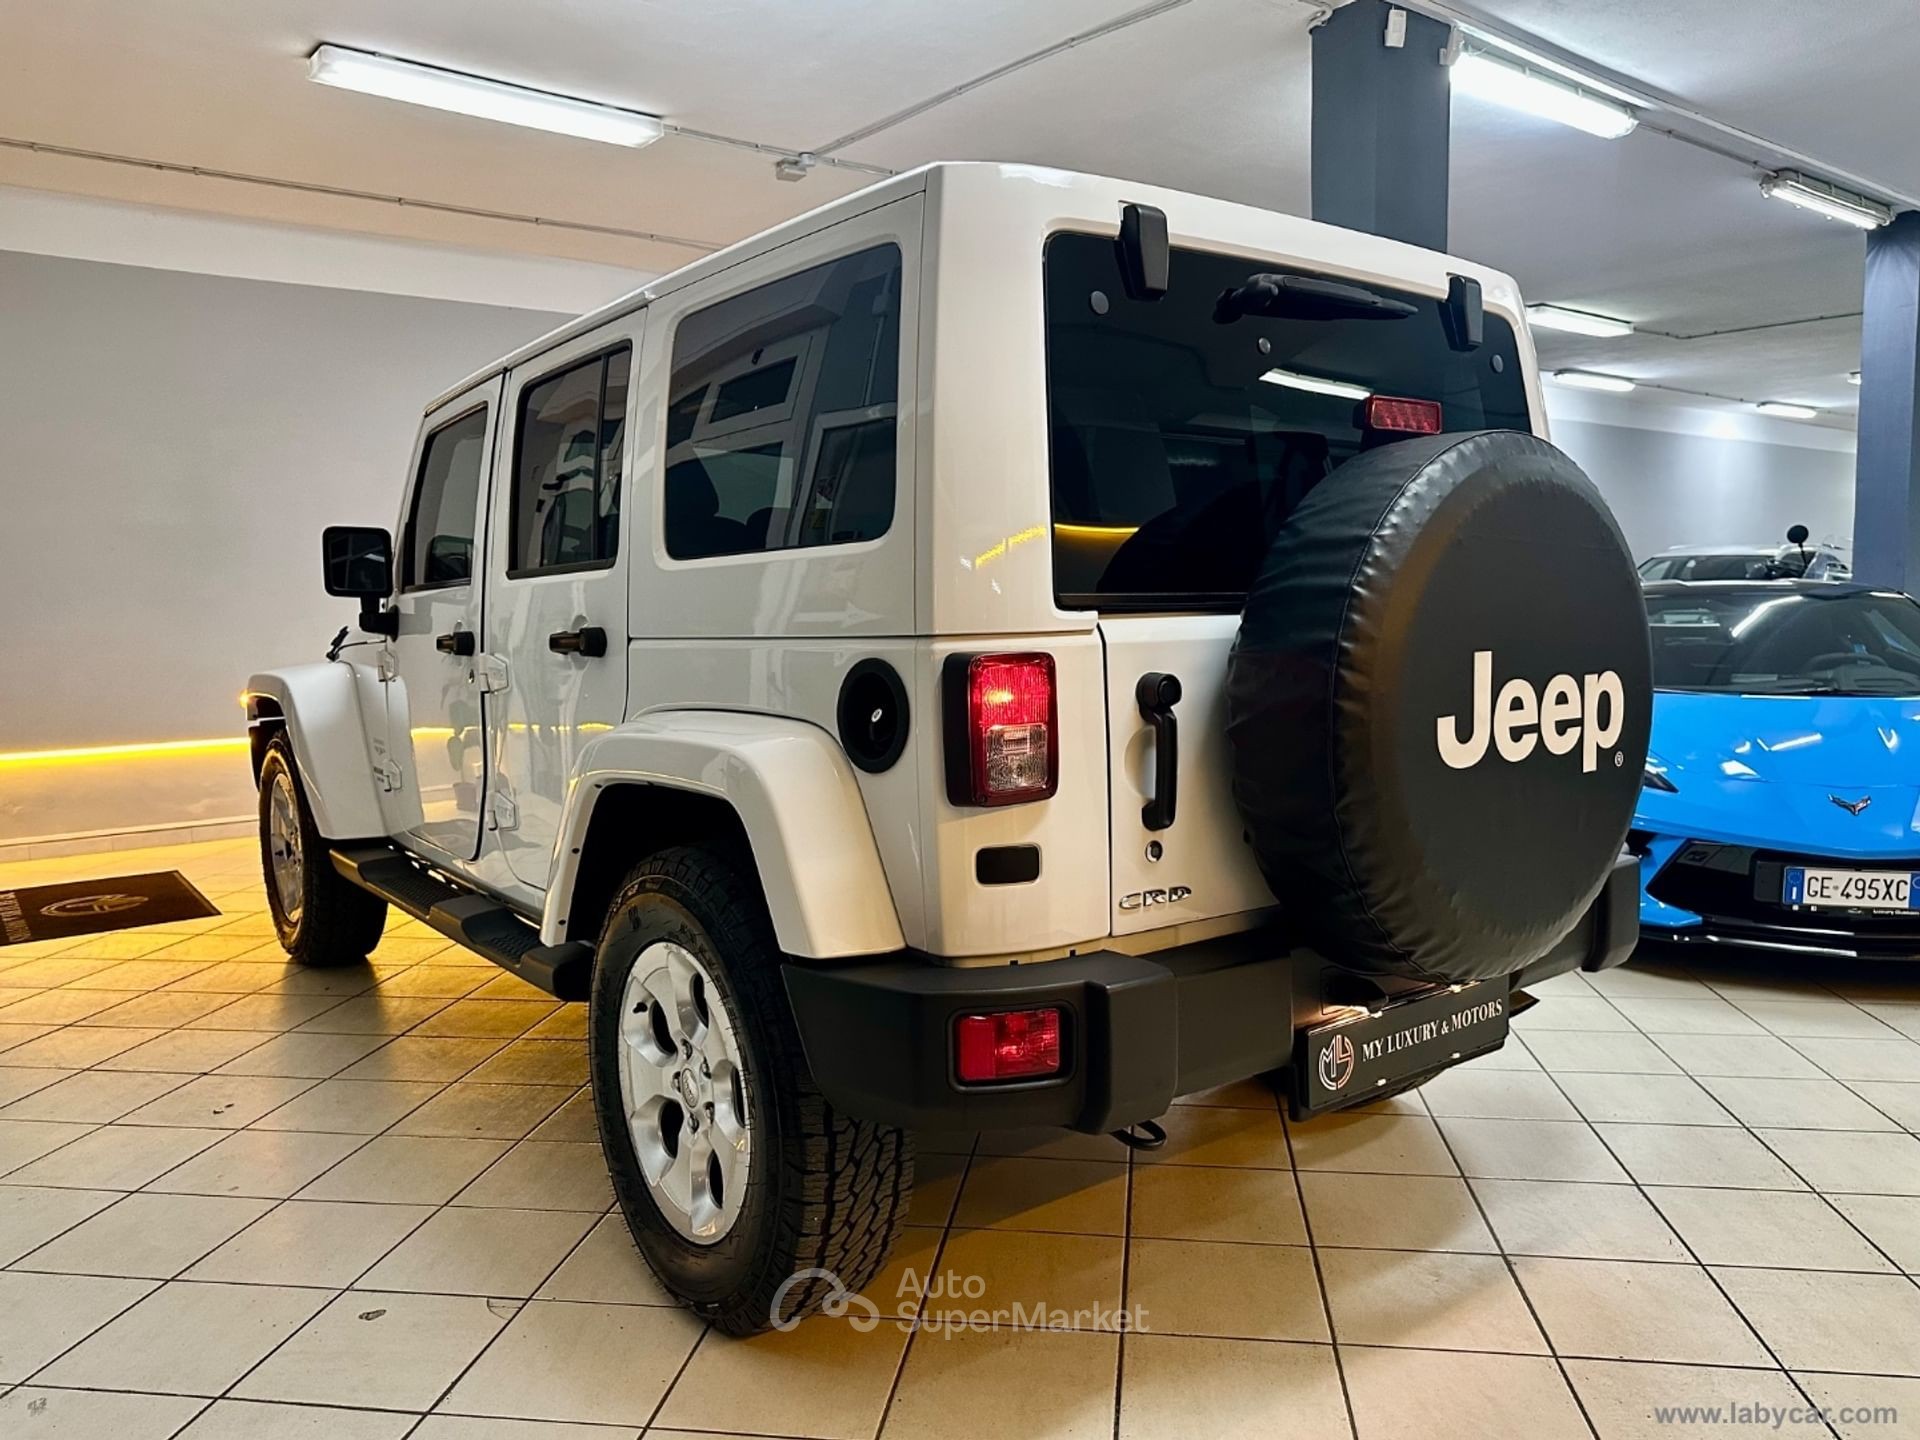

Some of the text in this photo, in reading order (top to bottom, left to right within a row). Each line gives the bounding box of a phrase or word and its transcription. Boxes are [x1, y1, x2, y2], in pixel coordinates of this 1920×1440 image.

[1437, 650, 1625, 773] Jeep
[1119, 886, 1192, 910] CRD
[1807, 877, 1908, 901] GE 495XC
[1362, 998, 1503, 1063] MY LUXURY & MOTORS
